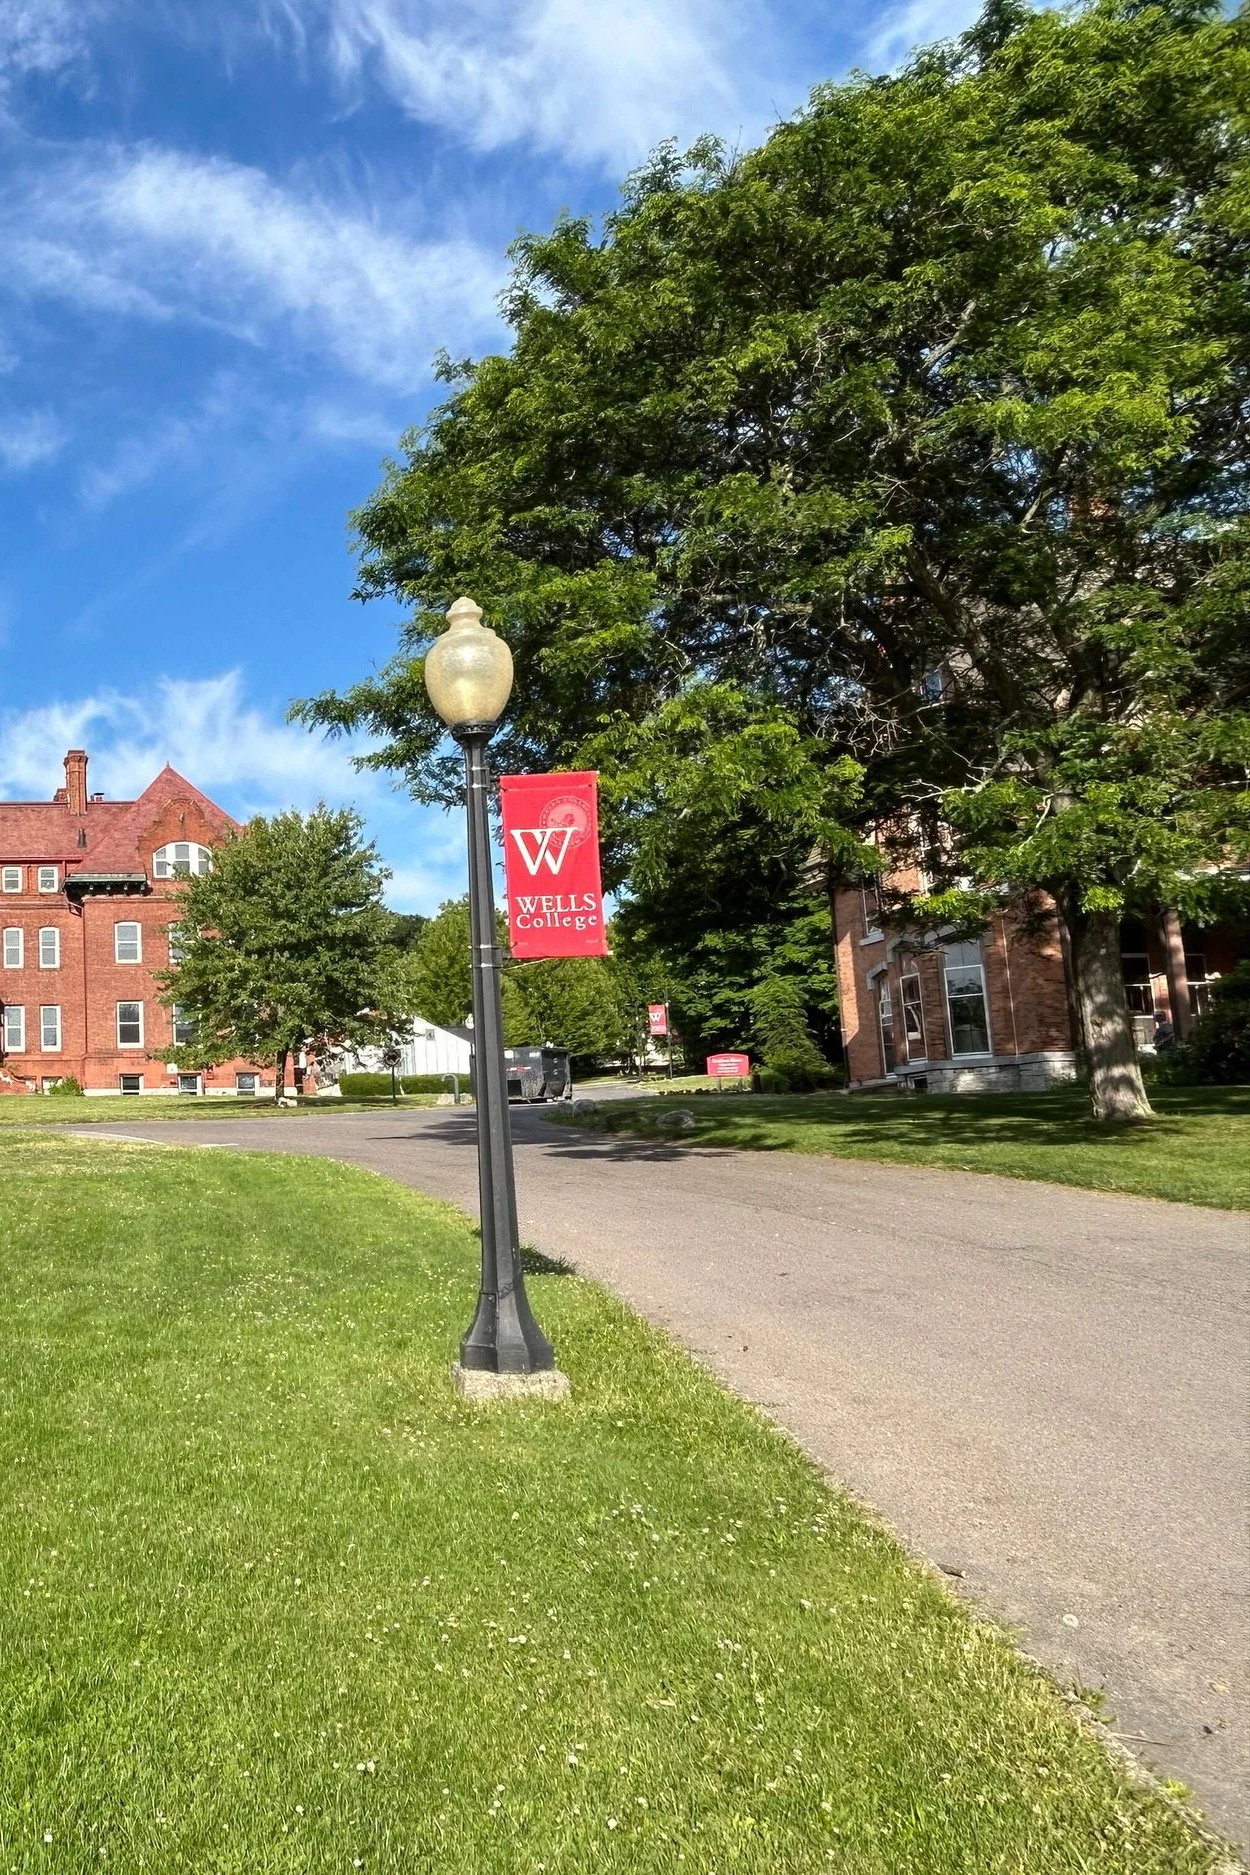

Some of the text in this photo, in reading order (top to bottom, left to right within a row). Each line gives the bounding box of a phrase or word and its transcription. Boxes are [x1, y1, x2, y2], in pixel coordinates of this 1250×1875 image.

[510, 827, 578, 875] W
[515, 893, 597, 914] WELLS
[516, 912, 598, 931] College
